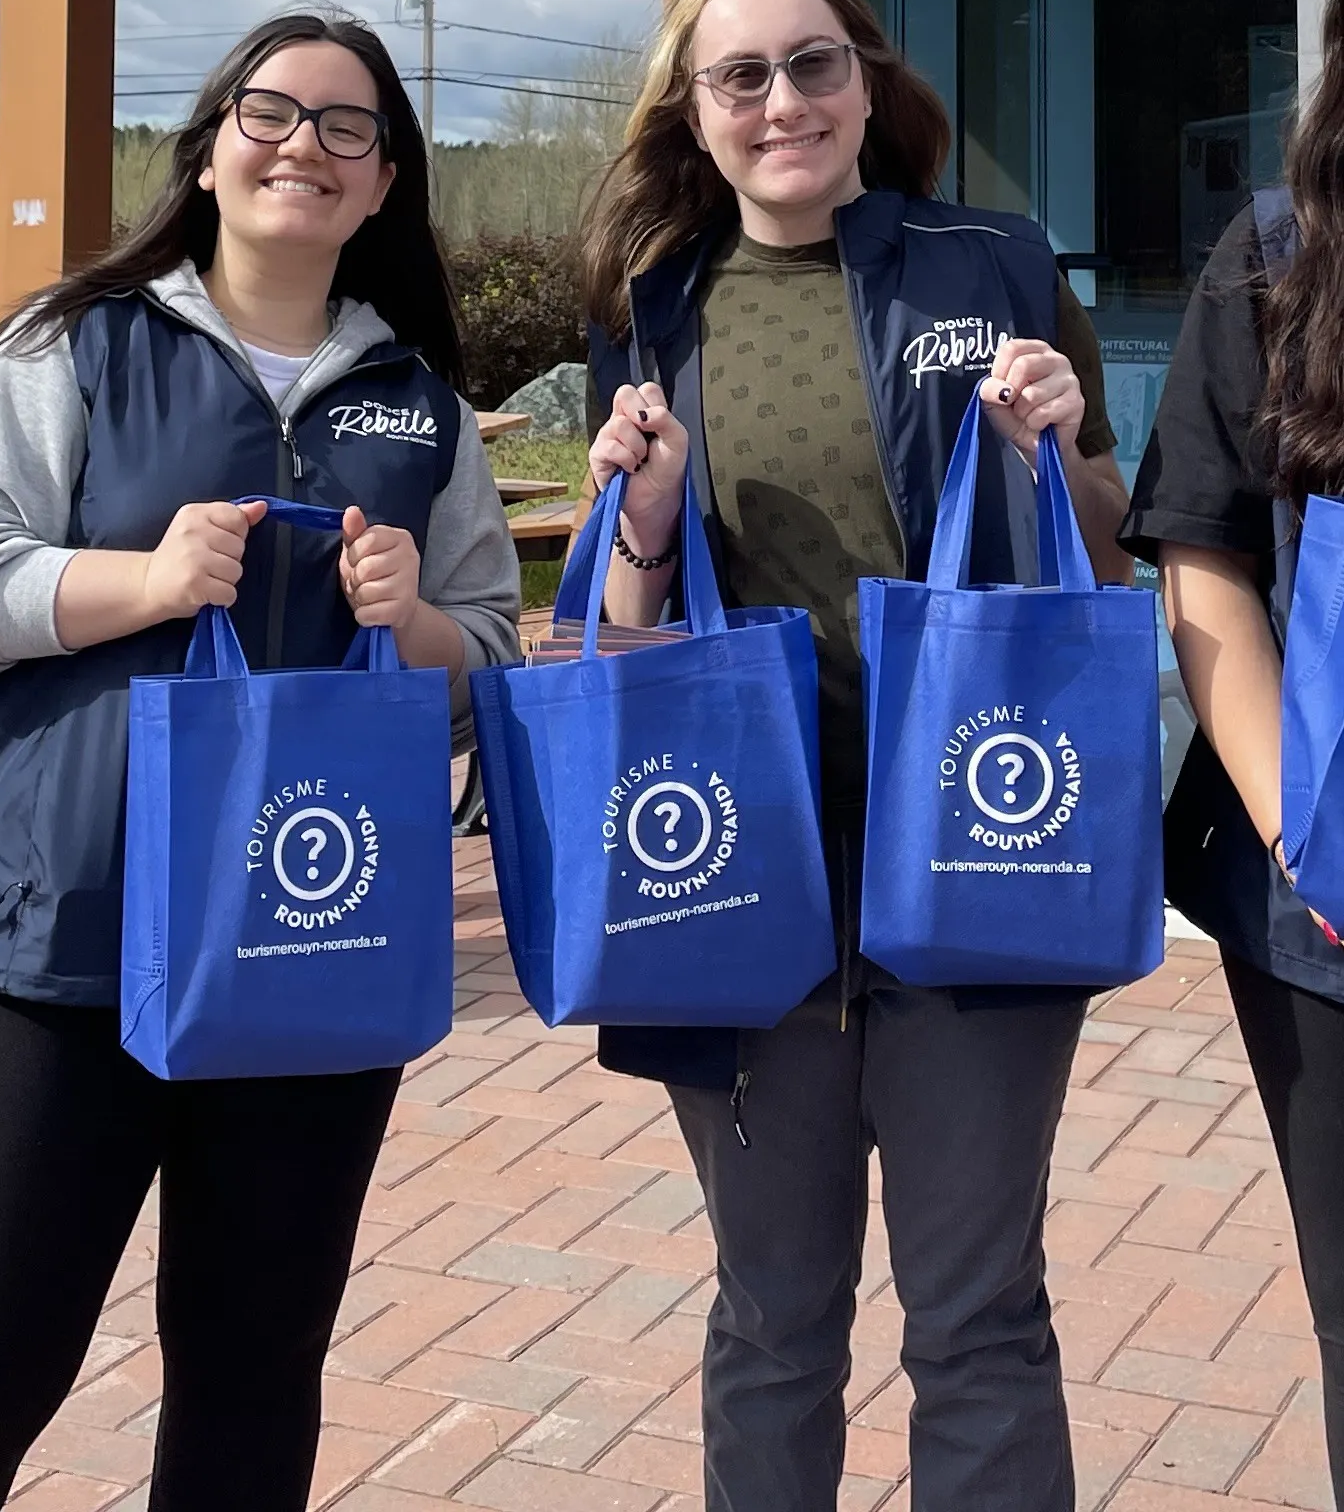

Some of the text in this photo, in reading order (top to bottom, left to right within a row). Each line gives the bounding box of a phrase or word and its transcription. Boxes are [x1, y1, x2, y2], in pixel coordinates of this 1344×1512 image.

[933, 317, 984, 332] DOUCE
[328, 405, 437, 440] Rebelle
[362, 400, 411, 416] DOUCE
[939, 704, 1025, 790] TOURISME
[603, 753, 673, 854] TOURISME
[968, 731, 1081, 851] ROUYN-NORANDA
[246, 778, 327, 872] TOURISME
[637, 770, 738, 899] ROUYN-NORANDA
[273, 804, 380, 930] ROUYN-NORANDA
[930, 859, 1092, 875] tourismerouyn-noranda.ca
[604, 891, 760, 935] tourismerouyn-noranda.ca
[236, 934, 387, 959] tourismerouyn-noranda.ca
